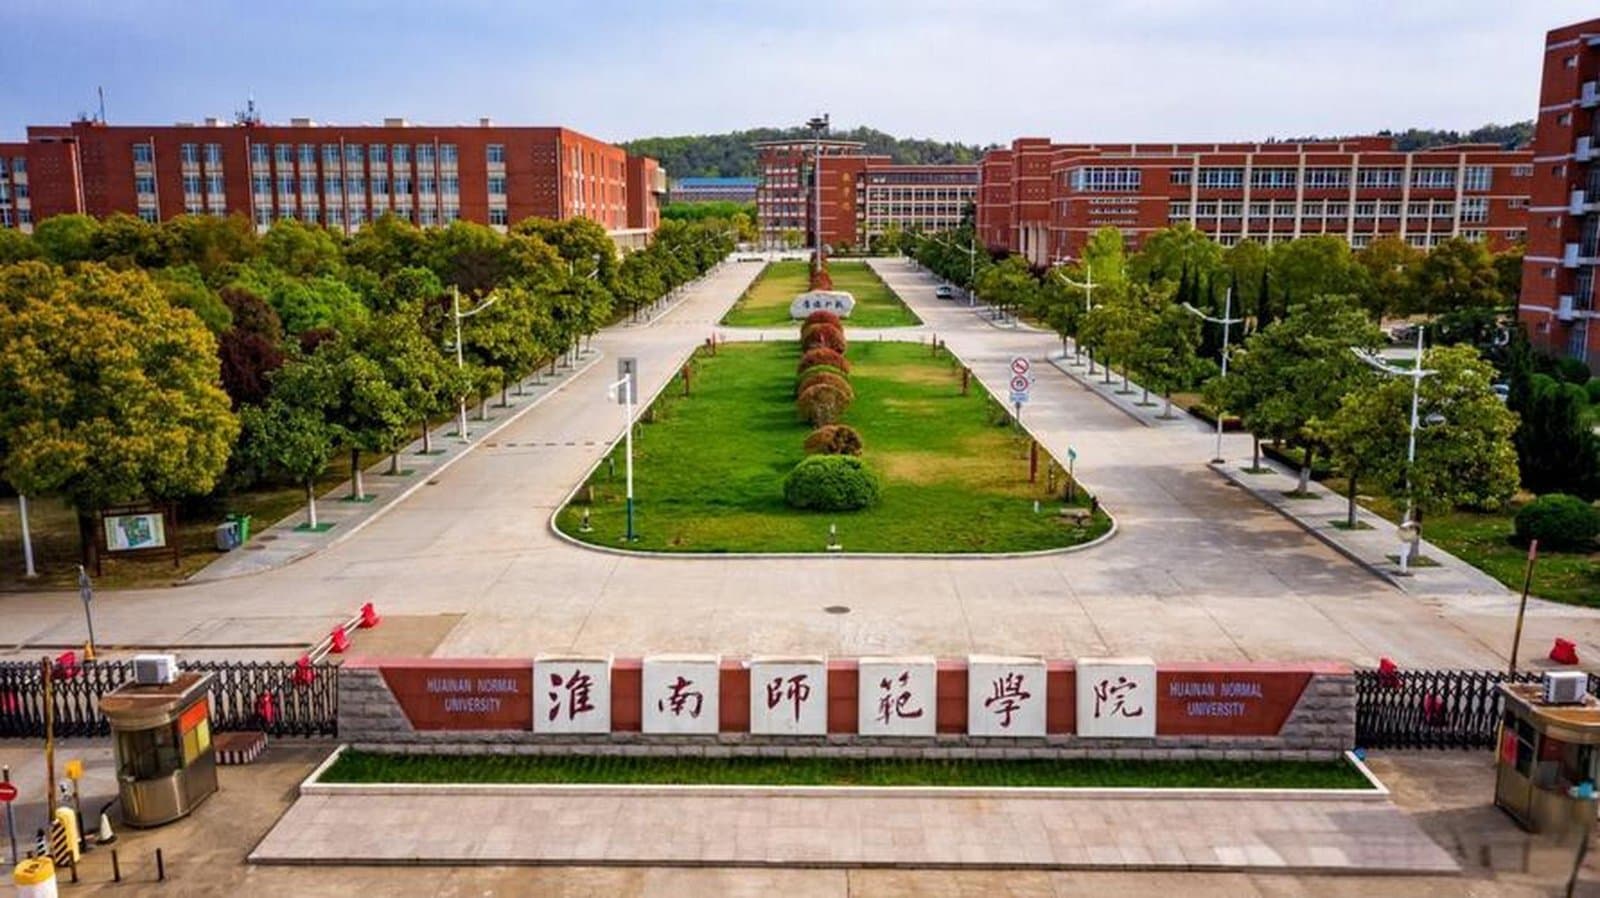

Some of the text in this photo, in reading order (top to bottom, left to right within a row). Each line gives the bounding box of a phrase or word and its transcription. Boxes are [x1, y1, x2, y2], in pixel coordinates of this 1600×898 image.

[426, 678, 519, 693] HUAINAN NORMAL
[1169, 681, 1263, 698] HUAINAN NORMAL
[444, 697, 501, 713] UNIVERSITY
[1187, 701, 1246, 717] UNIVERSITY
